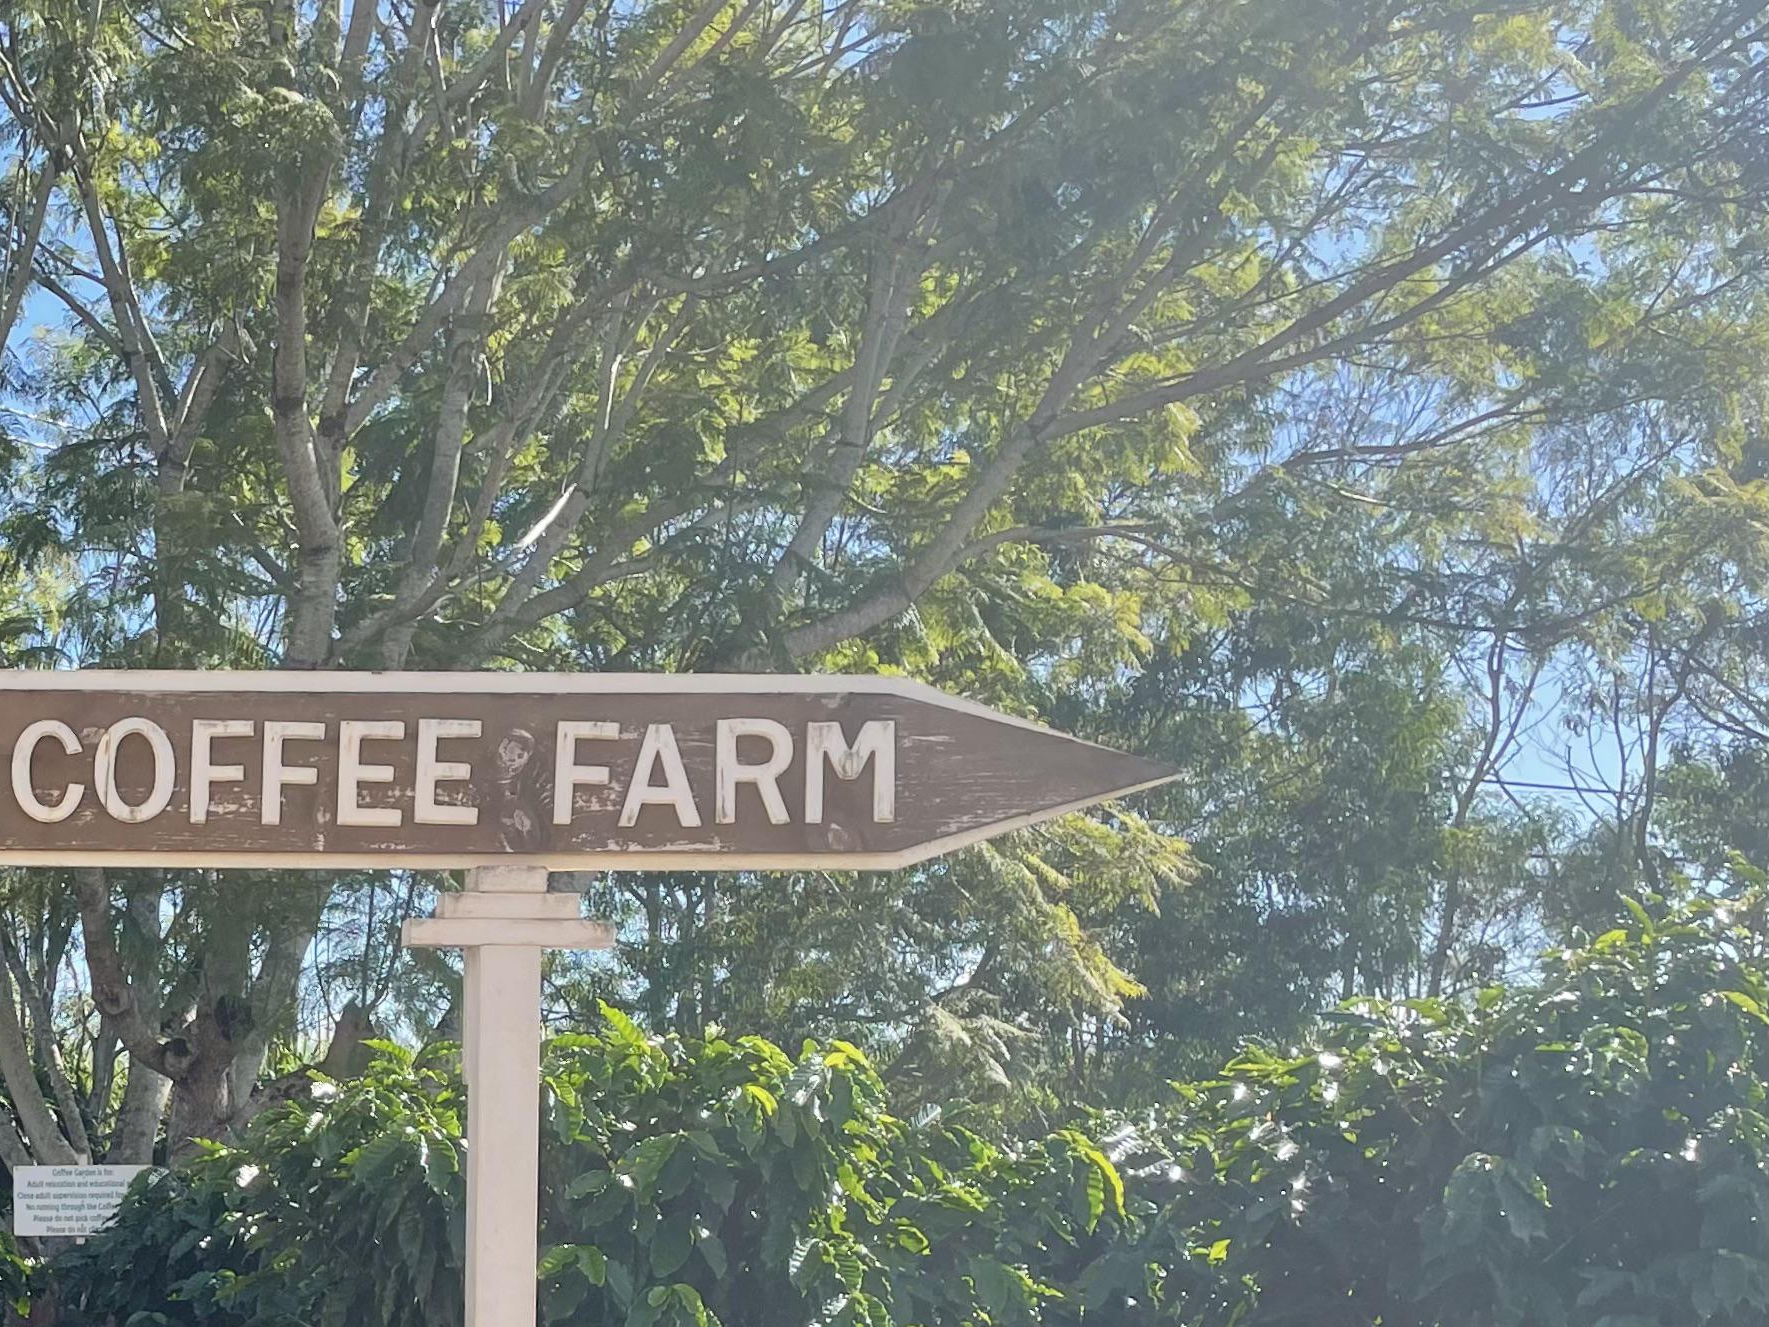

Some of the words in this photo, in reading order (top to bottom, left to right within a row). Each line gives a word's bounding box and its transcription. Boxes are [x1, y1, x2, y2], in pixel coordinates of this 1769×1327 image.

[10, 717, 483, 828] COFFEE
[552, 718, 895, 828] FARM
[52, 1168, 73, 1176] Coffee
[74, 1168, 96, 1176] Garden
[53, 1192, 87, 1200] supervision
[88, 1192, 113, 1200] required
[36, 1203, 59, 1212] running
[61, 1203, 85, 1212] through
